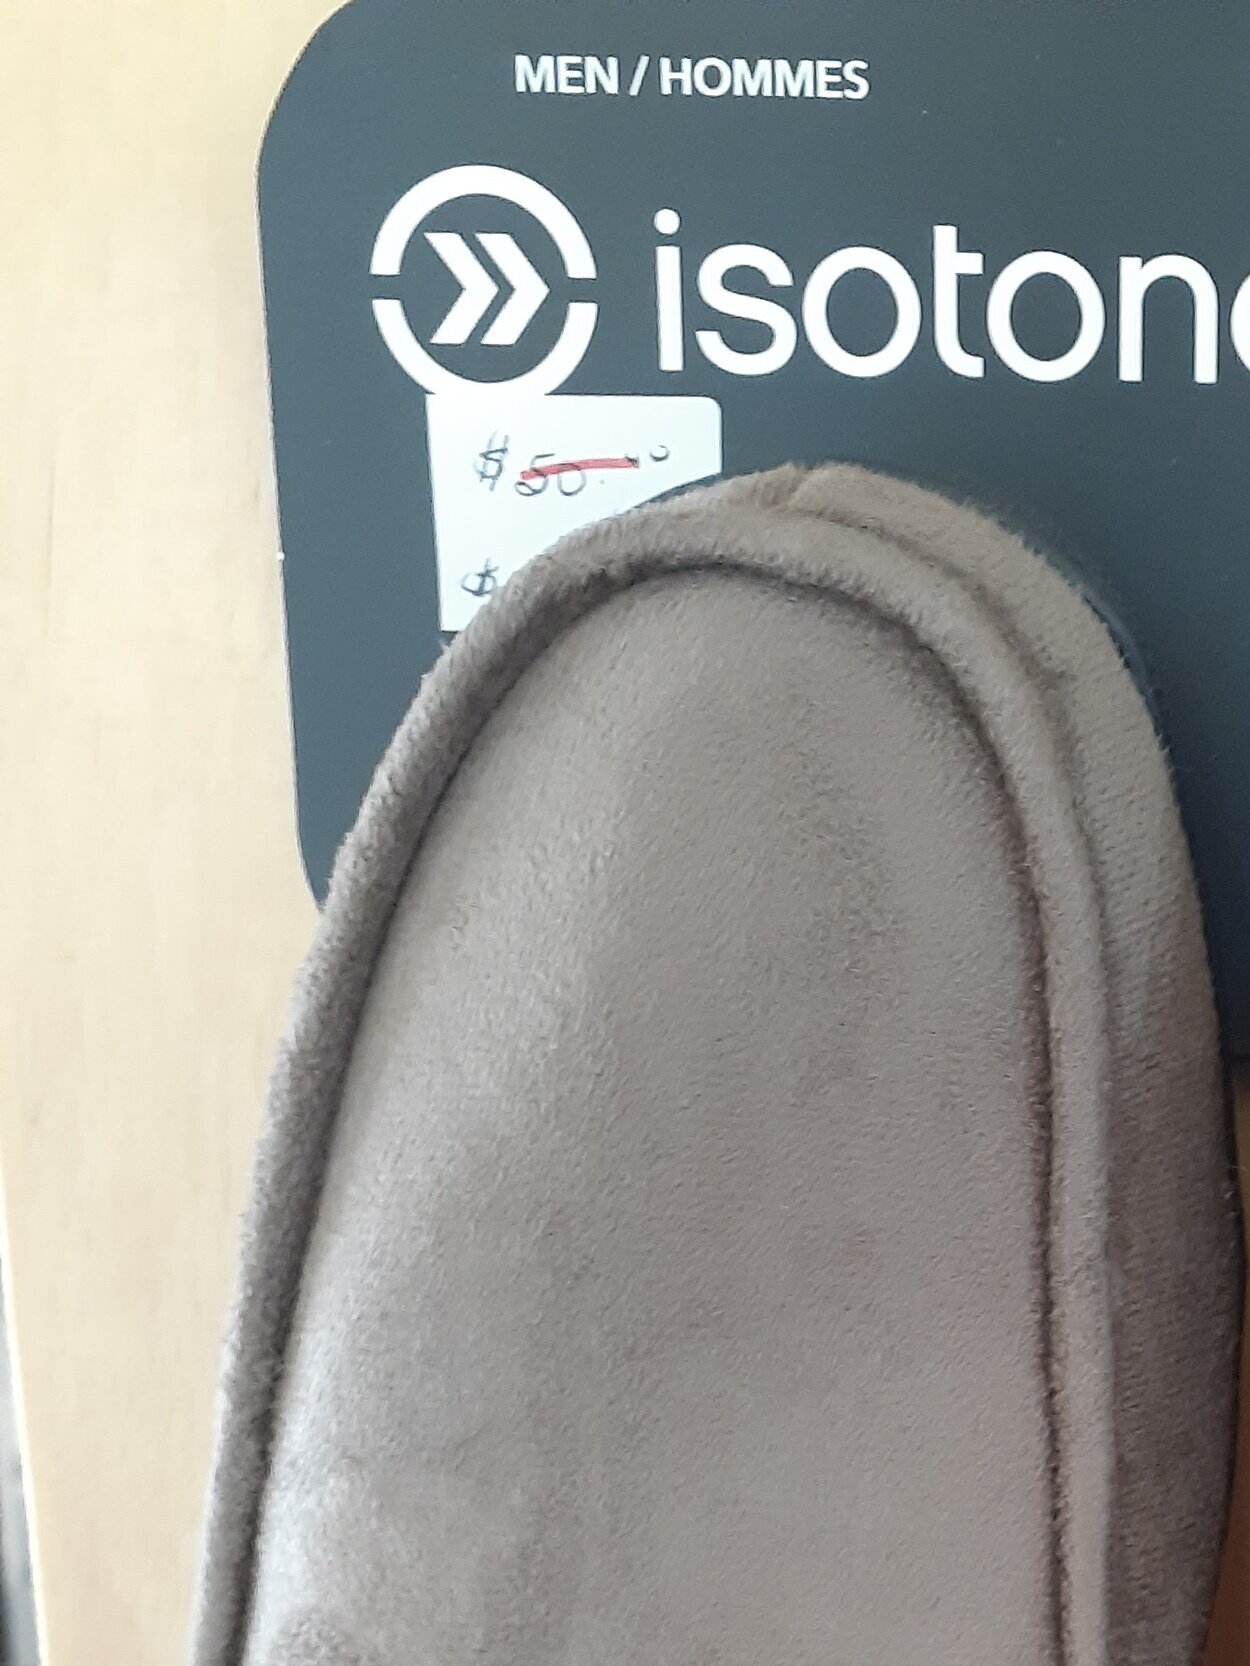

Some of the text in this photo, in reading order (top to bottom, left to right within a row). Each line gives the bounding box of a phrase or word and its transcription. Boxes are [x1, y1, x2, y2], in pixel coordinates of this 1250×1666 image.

[513, 54, 871, 100] MEN / HOMMES
